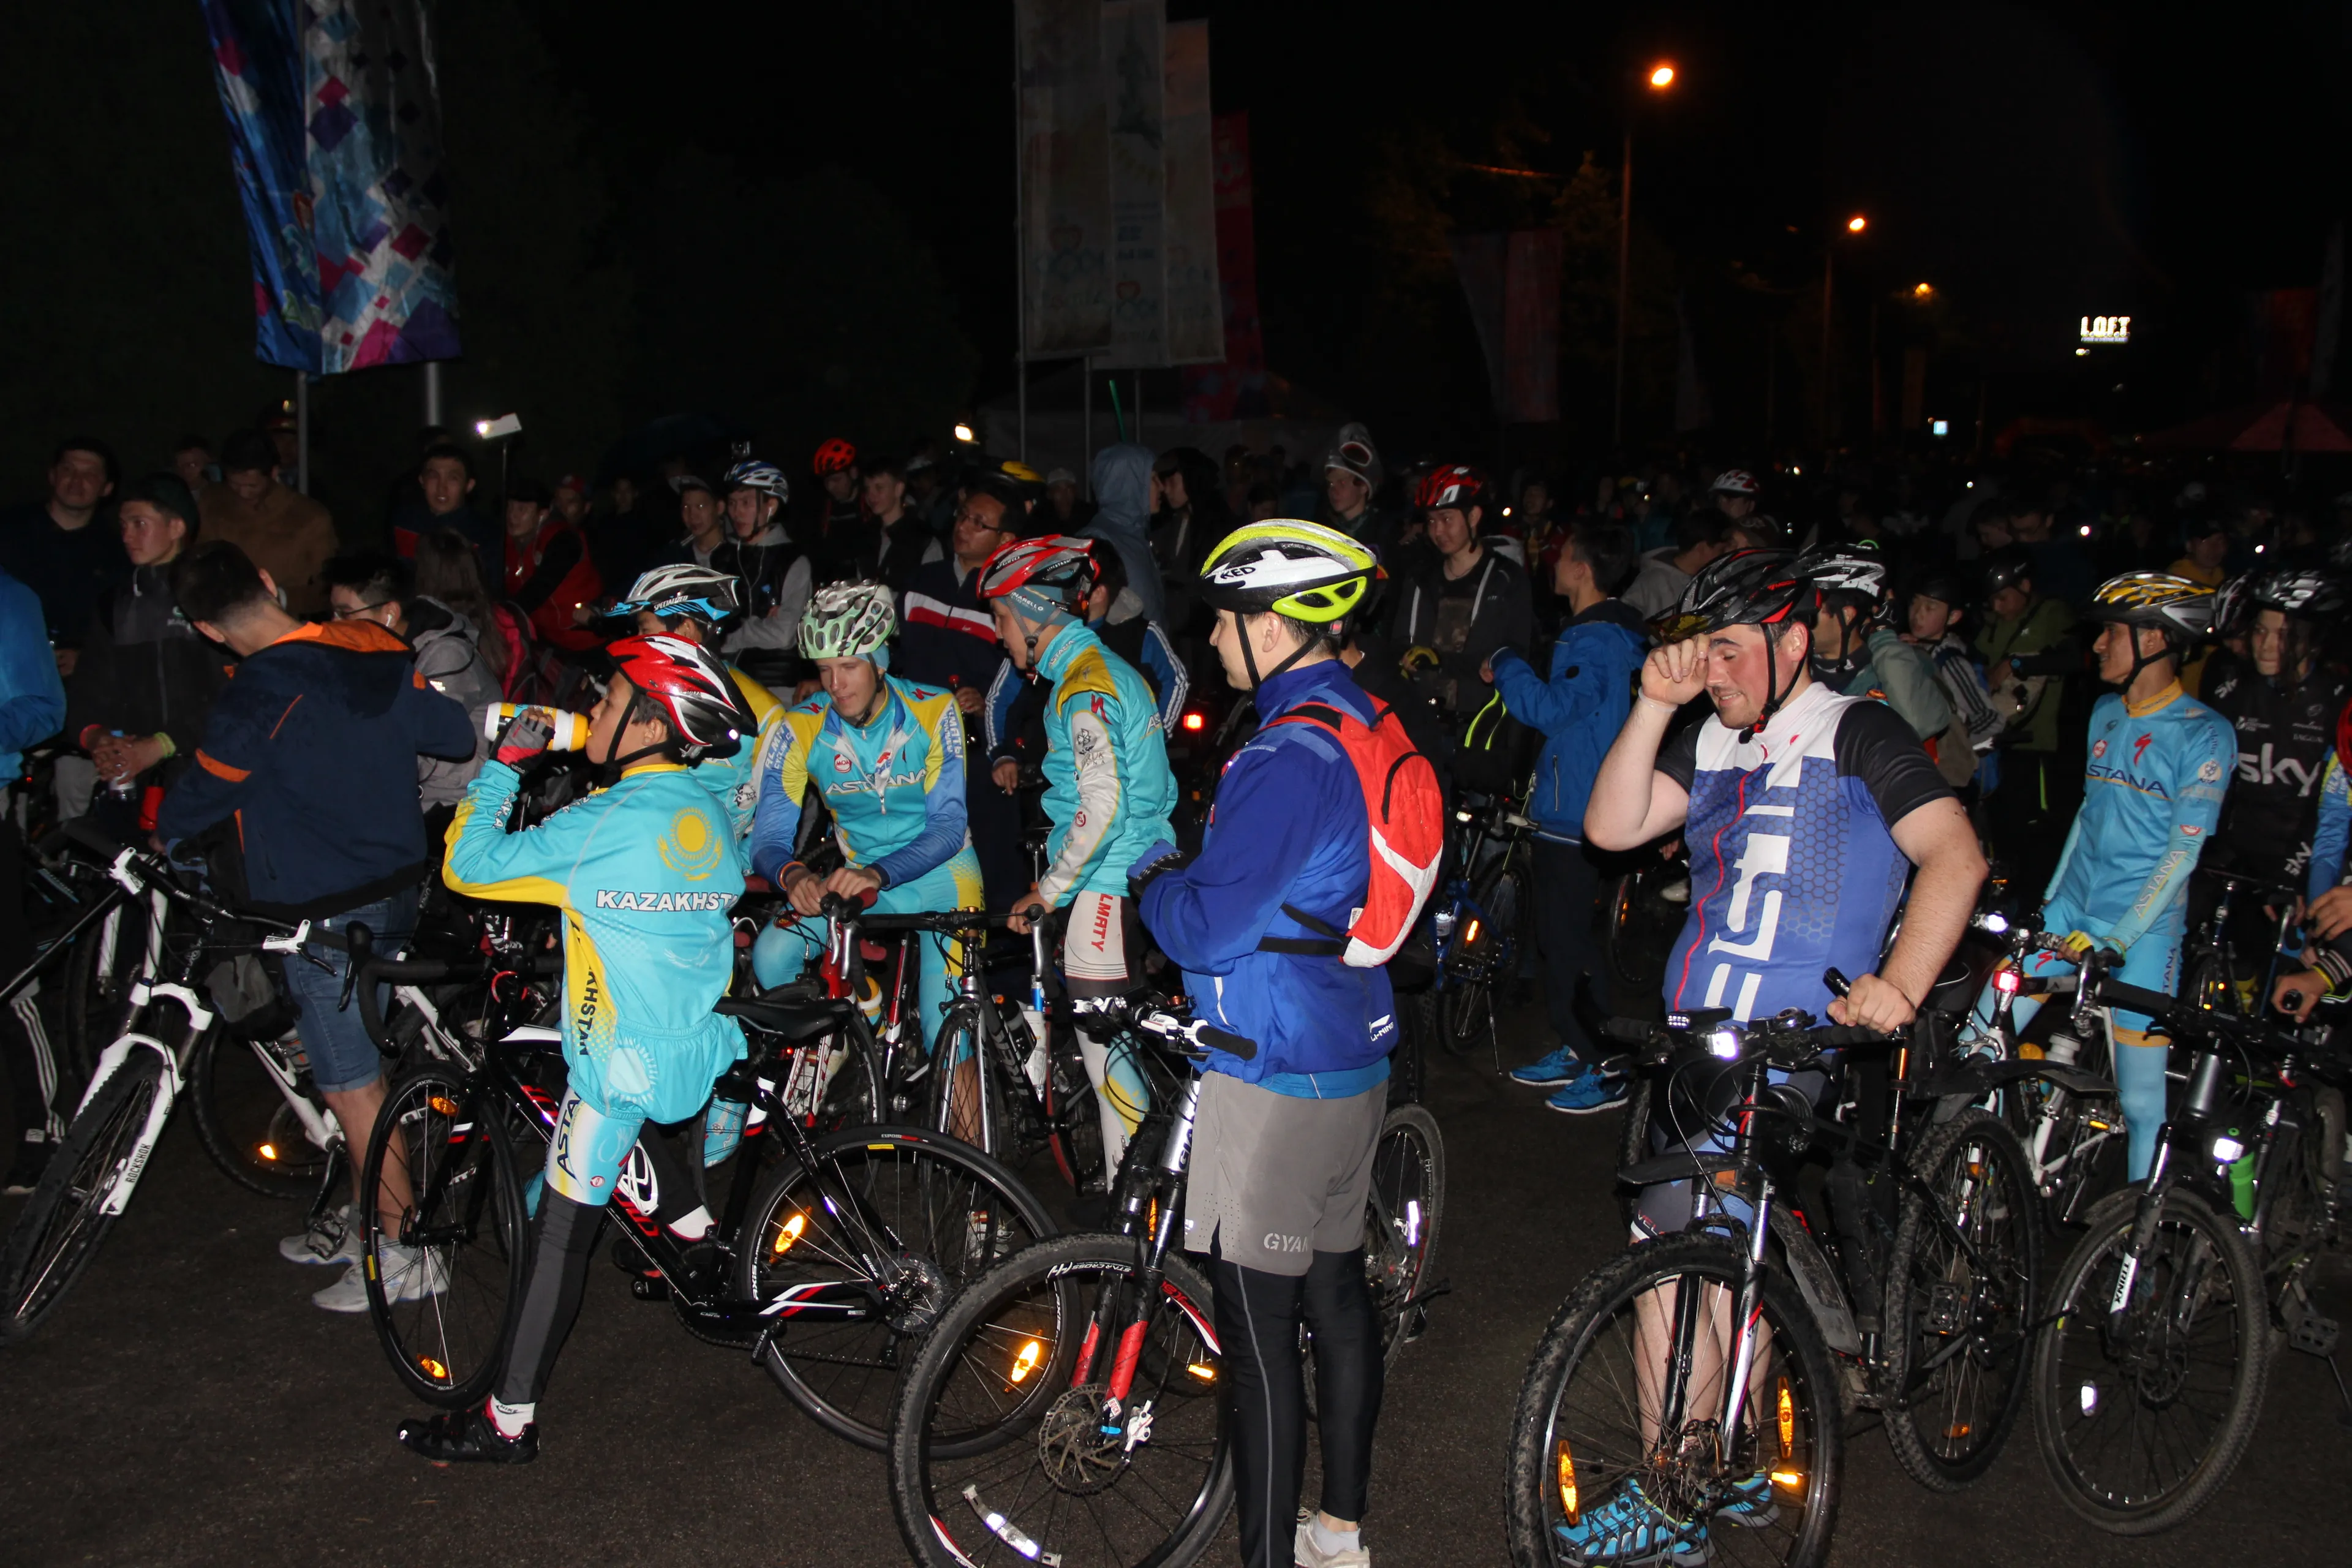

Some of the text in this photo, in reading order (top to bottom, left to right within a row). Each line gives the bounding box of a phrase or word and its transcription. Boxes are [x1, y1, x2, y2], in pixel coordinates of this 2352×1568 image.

[1221, 567, 1256, 579] KED
[654, 595, 689, 610] SPECIALIZED
[2239, 742, 2322, 797] sky
[2134, 850, 2187, 919] ASTANA
[557, 1092, 581, 1180] ASTA
[2115, 1263, 2129, 1304] TRINX
